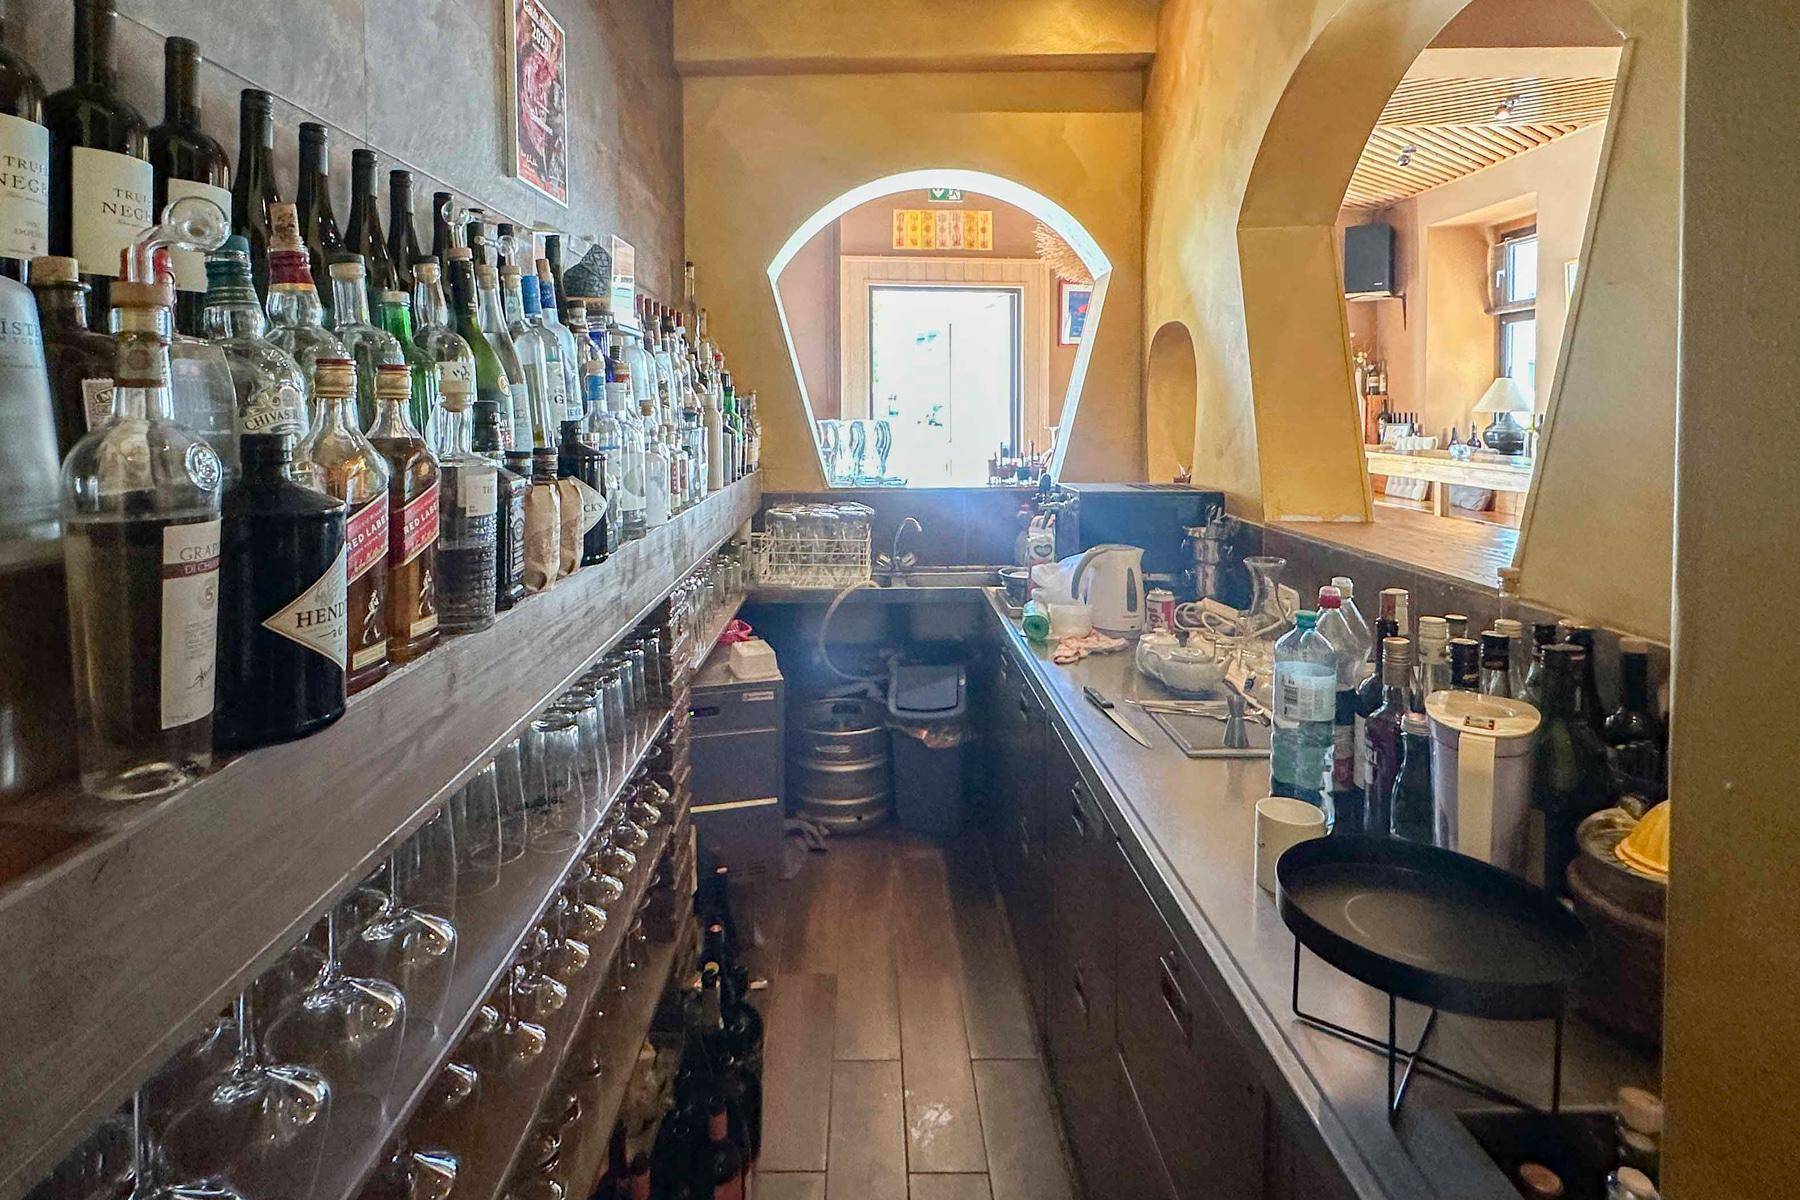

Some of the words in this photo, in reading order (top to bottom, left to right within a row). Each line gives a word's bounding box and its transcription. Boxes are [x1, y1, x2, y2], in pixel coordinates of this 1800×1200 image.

[244, 409, 290, 431] CHIVAS
[403, 518, 420, 536] RED
[346, 533, 365, 552] RED
[295, 601, 344, 629] HEND
